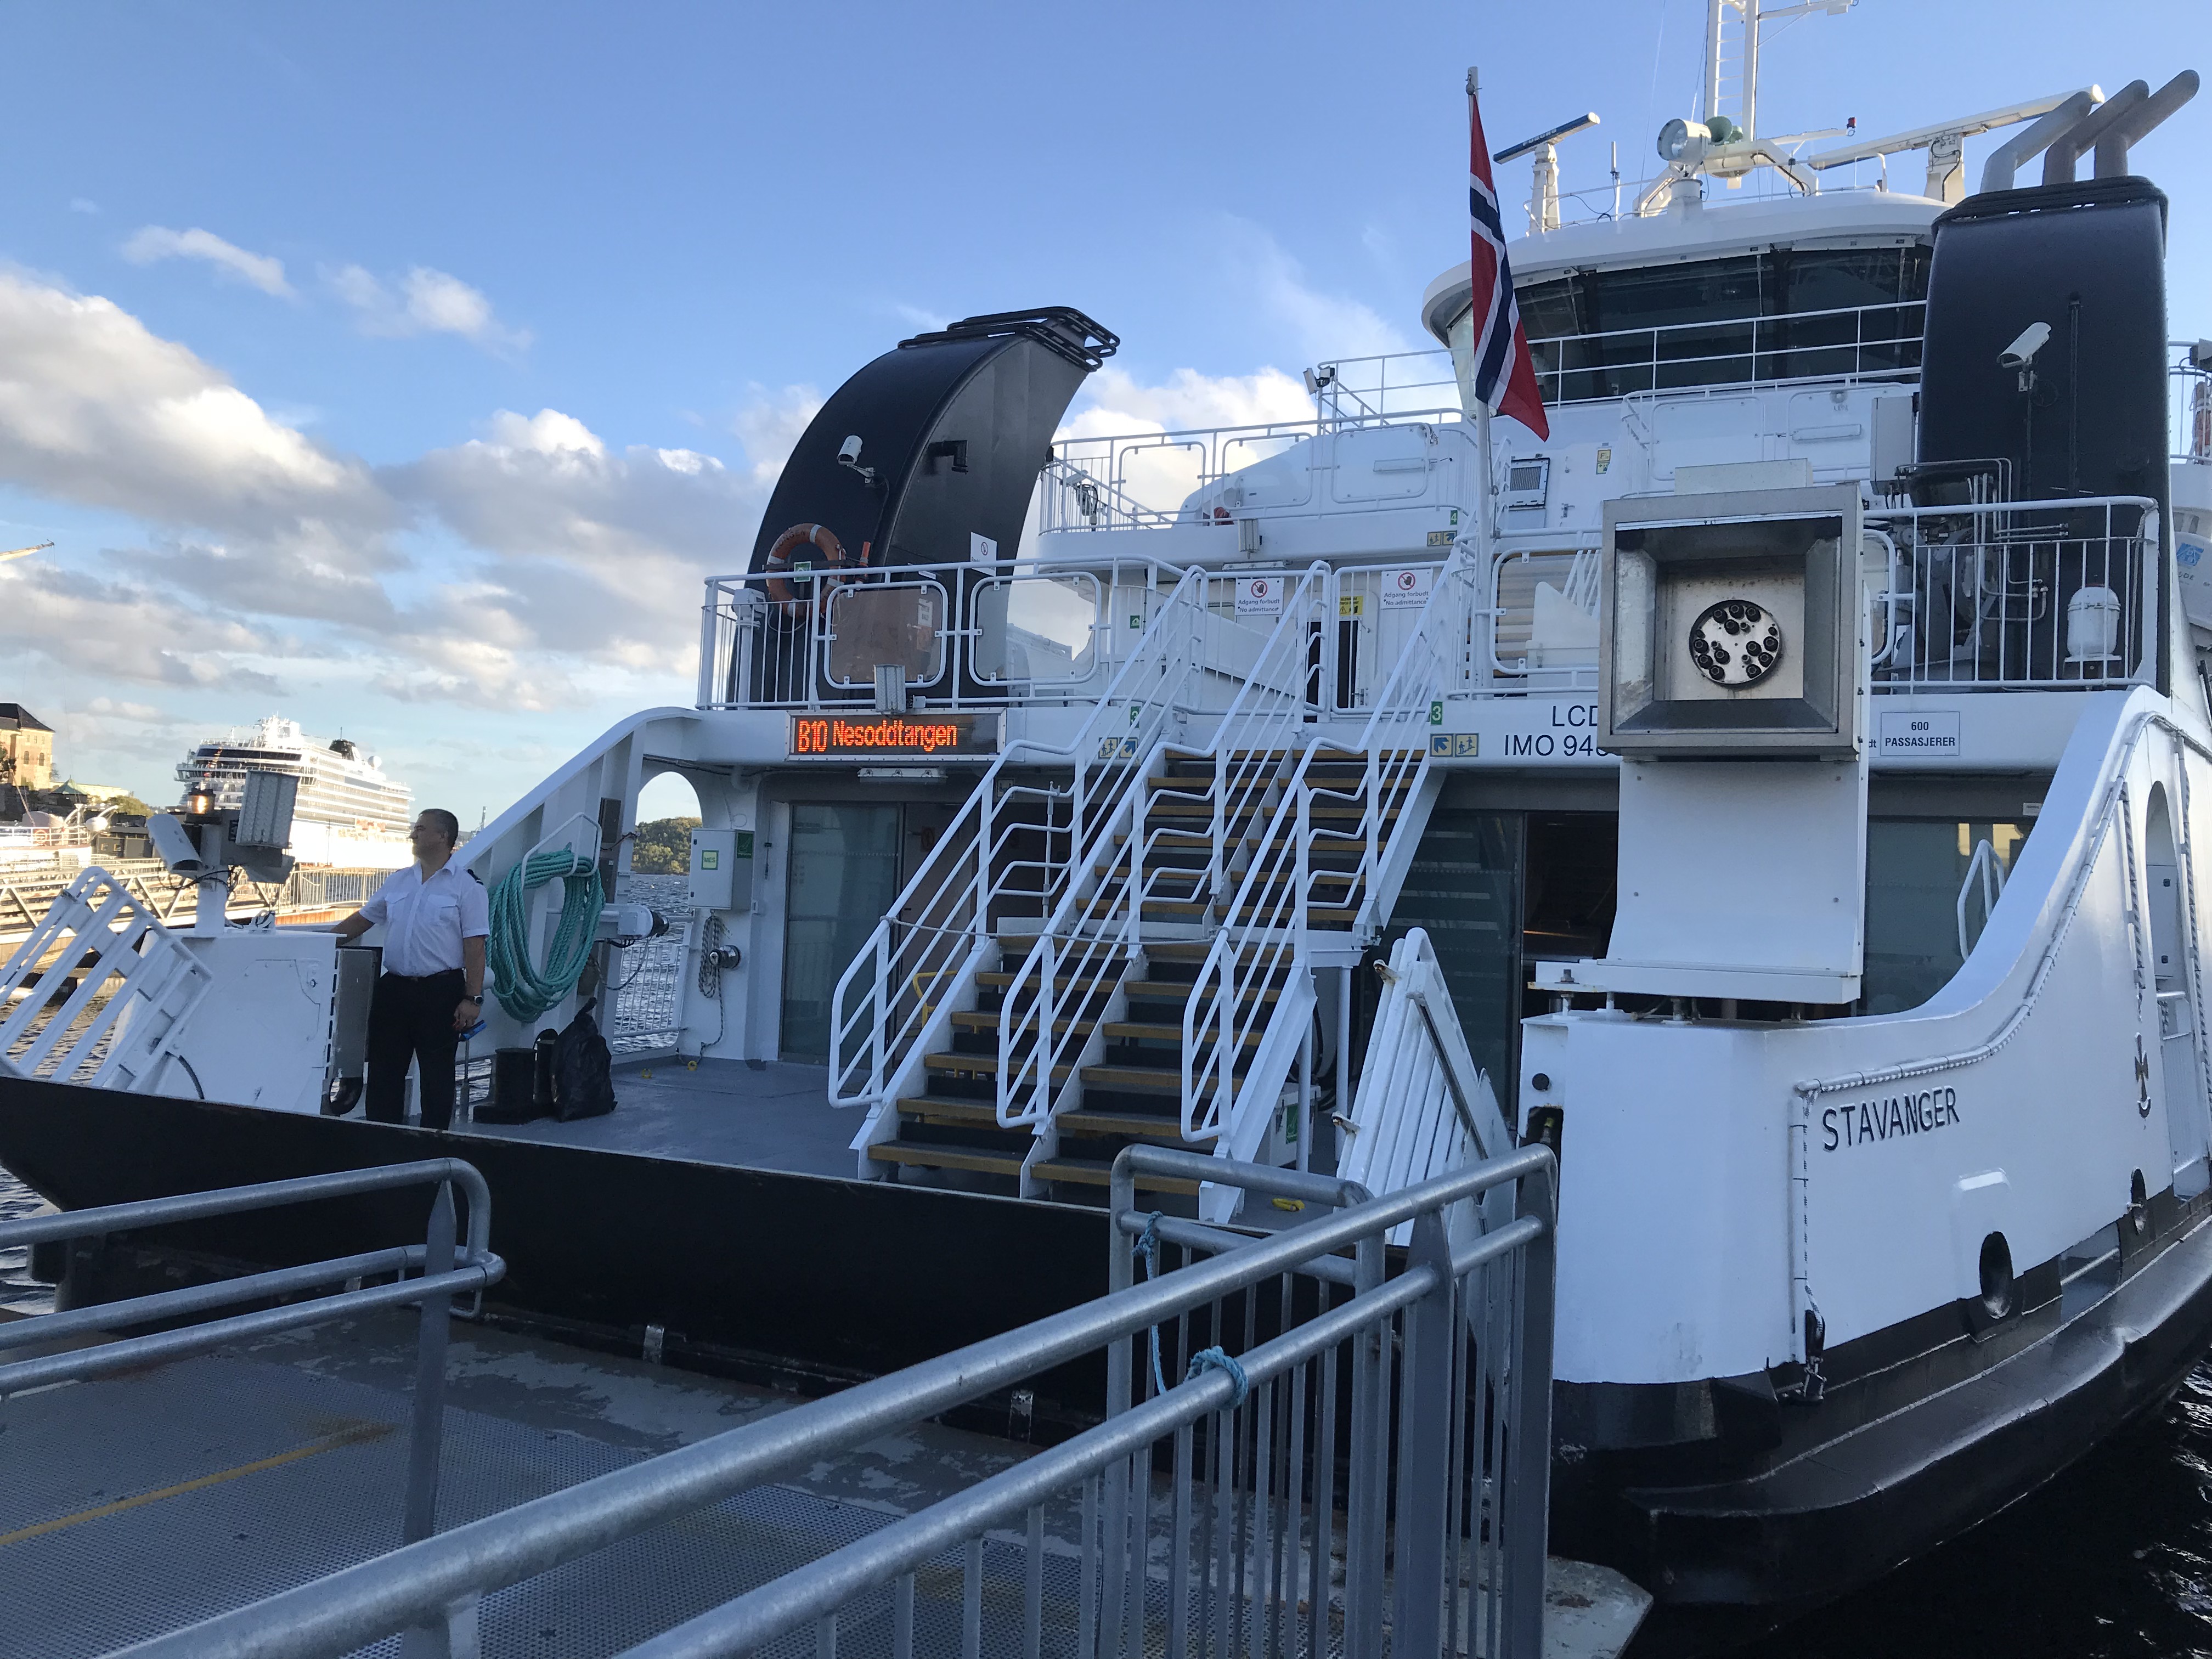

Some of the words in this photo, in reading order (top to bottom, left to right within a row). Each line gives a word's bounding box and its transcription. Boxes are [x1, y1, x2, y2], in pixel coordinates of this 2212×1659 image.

[1451, 512, 1457, 522] 4
[1432, 706, 1441, 721] 3
[1911, 721, 1929, 731] 600
[798, 720, 828, 752] B10
[832, 719, 957, 752] Nesoddtangen
[1885, 737, 1955, 747] PASSASJERER
[1504, 734, 1554, 757] IMO
[1822, 1085, 1960, 1152] STAVANGER
